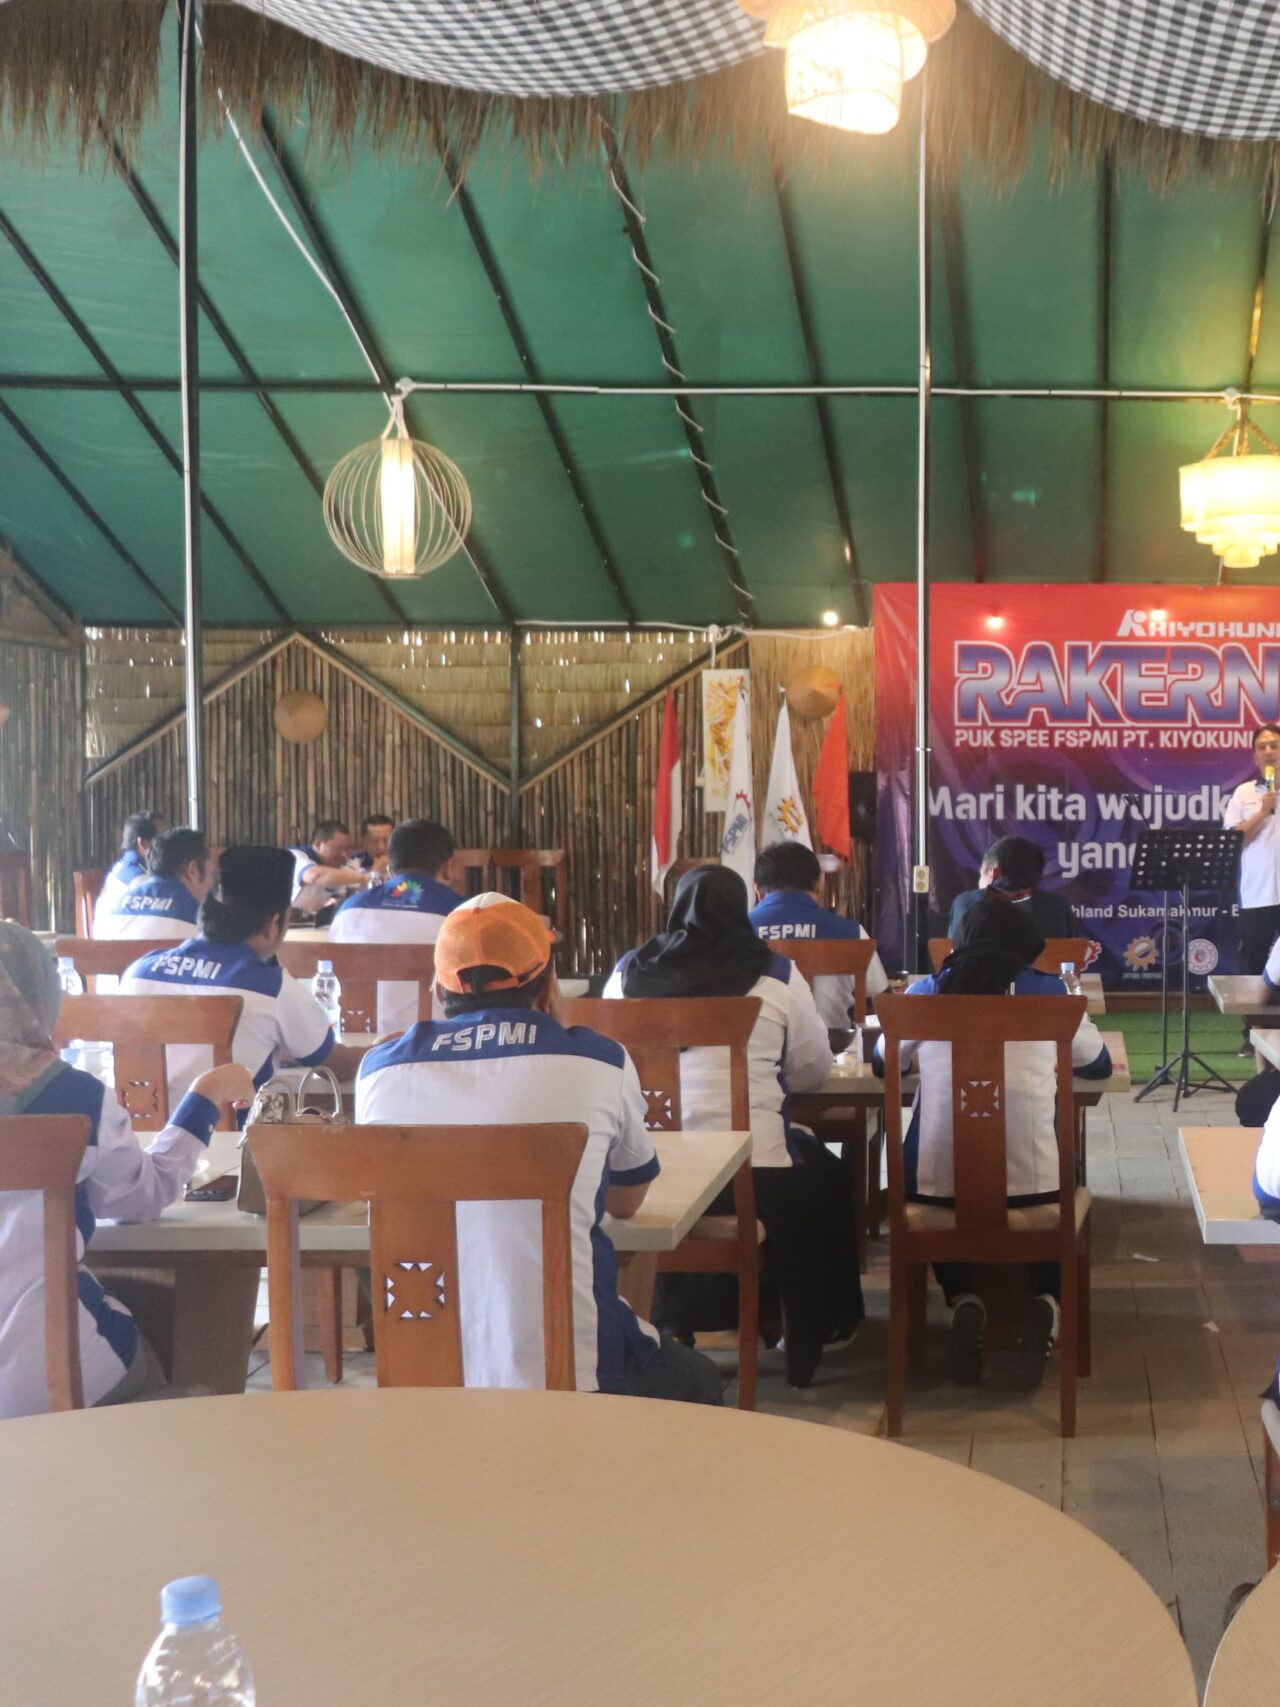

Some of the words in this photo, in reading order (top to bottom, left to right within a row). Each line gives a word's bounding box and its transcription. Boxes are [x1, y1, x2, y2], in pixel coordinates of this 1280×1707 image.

[955, 729, 995, 747] PUK
[1000, 729, 1049, 747] SPEE
[1054, 730, 1118, 748] FSPMI
[1122, 730, 1154, 748] PT.
[928, 784, 1004, 820] Mari
[1016, 784, 1086, 821] kita
[1096, 785, 1231, 830] wujudk
[122, 895, 173, 911] FSPMI
[1071, 905, 1113, 918] hland
[758, 924, 816, 942] FSPMI
[151, 955, 222, 980] FSPMI
[431, 1021, 537, 1052] FSPMI
